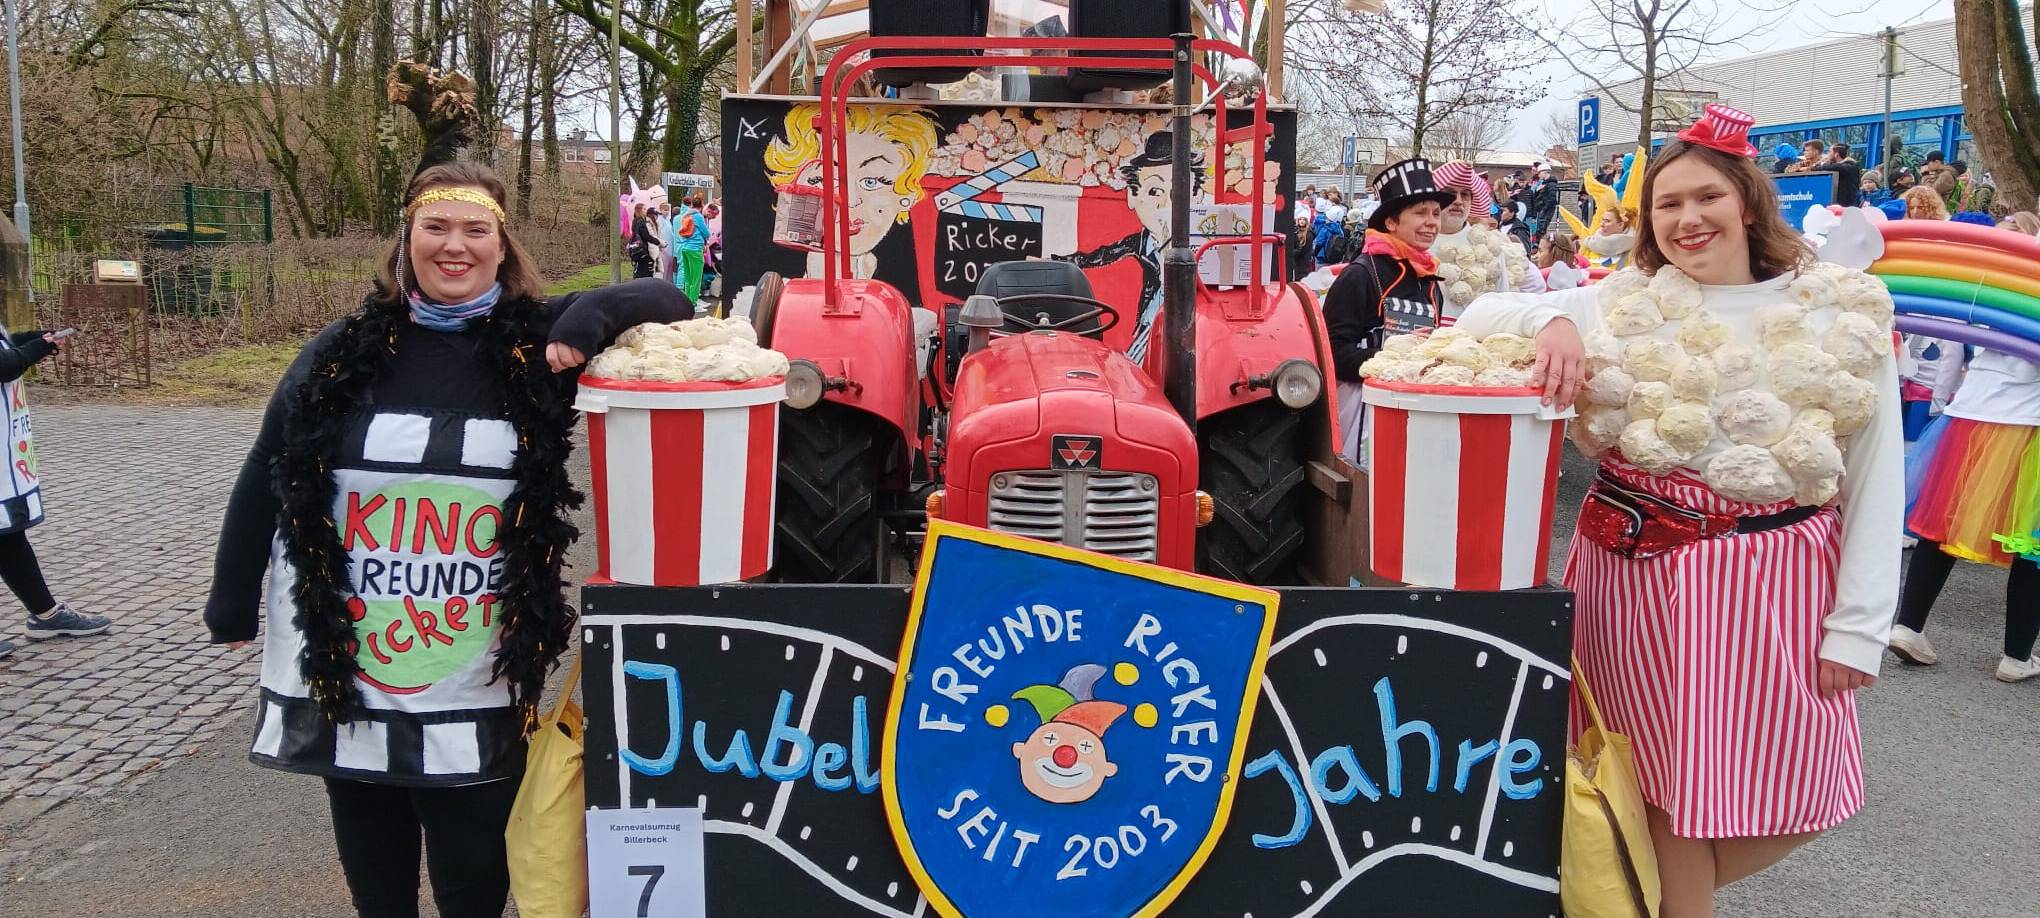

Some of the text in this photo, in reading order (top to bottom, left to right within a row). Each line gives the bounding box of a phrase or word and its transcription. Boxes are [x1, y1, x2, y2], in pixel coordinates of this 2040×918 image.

[1582, 104, 1593, 138] P
[946, 221, 1037, 252] Ricker
[944, 259, 992, 283] 20
[342, 491, 504, 559] KINO
[357, 557, 505, 599] REUNDE
[918, 604, 1219, 786] FREUNDE RICKER
[619, 660, 881, 795] Jubel
[609, 823, 681, 832] Karnevalsumzug
[623, 835, 668, 844] Billerbeck
[937, 788, 1179, 881] SEIT 2003
[627, 865, 665, 918] 7
